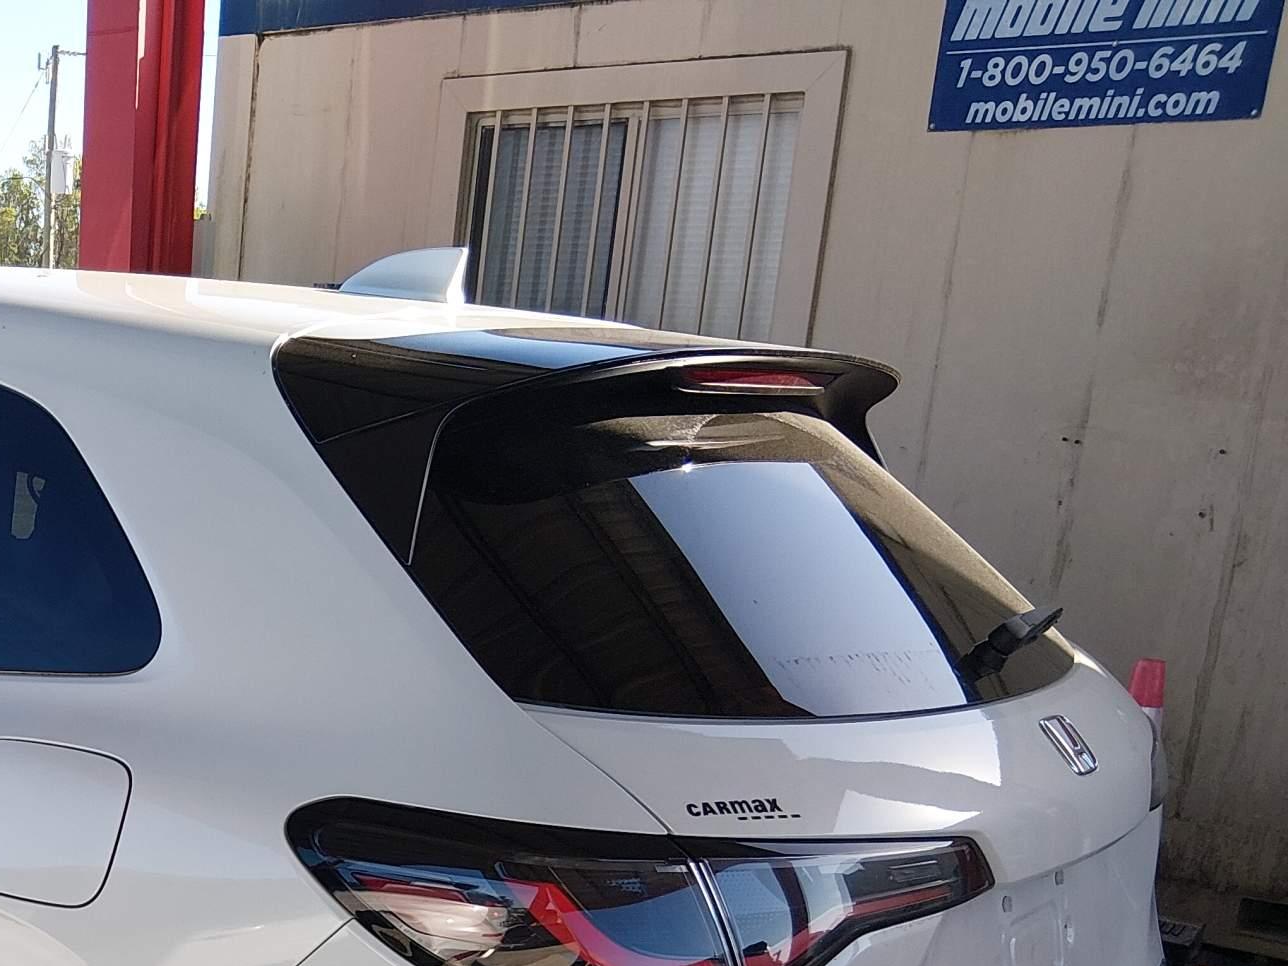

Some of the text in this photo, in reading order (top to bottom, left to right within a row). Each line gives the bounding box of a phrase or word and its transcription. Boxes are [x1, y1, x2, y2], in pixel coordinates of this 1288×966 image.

[950, 0, 1129, 41] mobile
[956, 41, 1248, 88] 1-800-950-6464
[965, 87, 1220, 123] mobilemini.com
